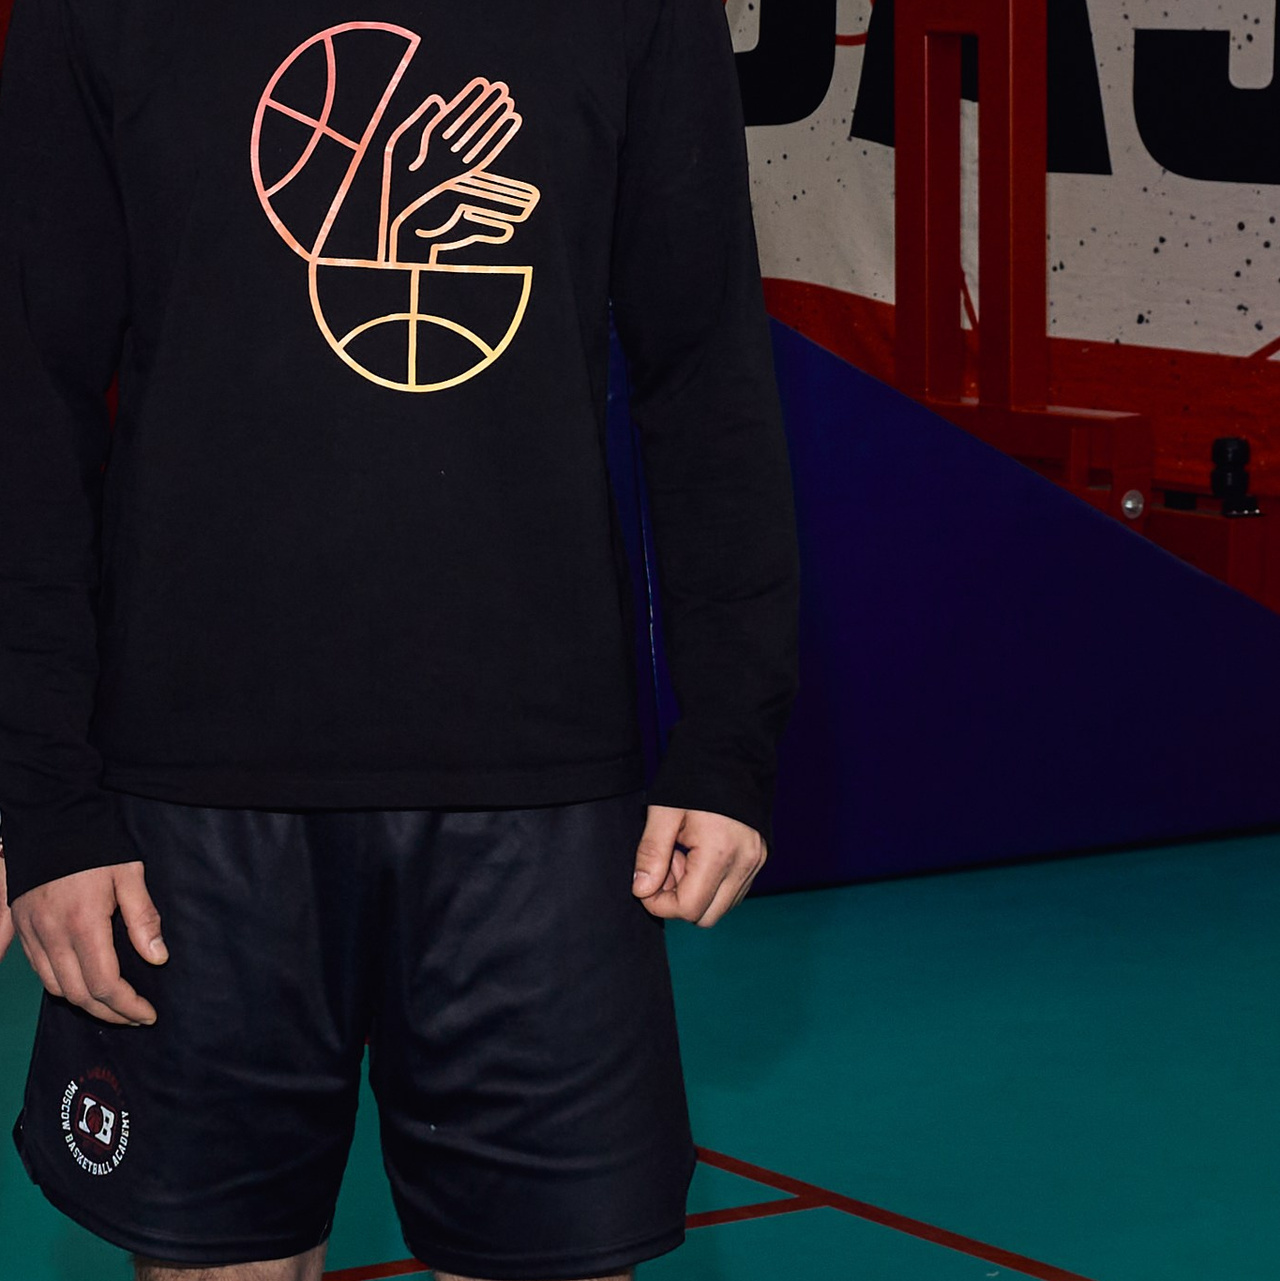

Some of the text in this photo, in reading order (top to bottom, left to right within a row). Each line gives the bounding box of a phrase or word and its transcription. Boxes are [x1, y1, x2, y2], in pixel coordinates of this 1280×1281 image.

[60, 1080, 79, 1131] MOSCOW
[64, 1133, 113, 1176] BASKETBALL
[112, 1110, 130, 1167] ACADEMY
